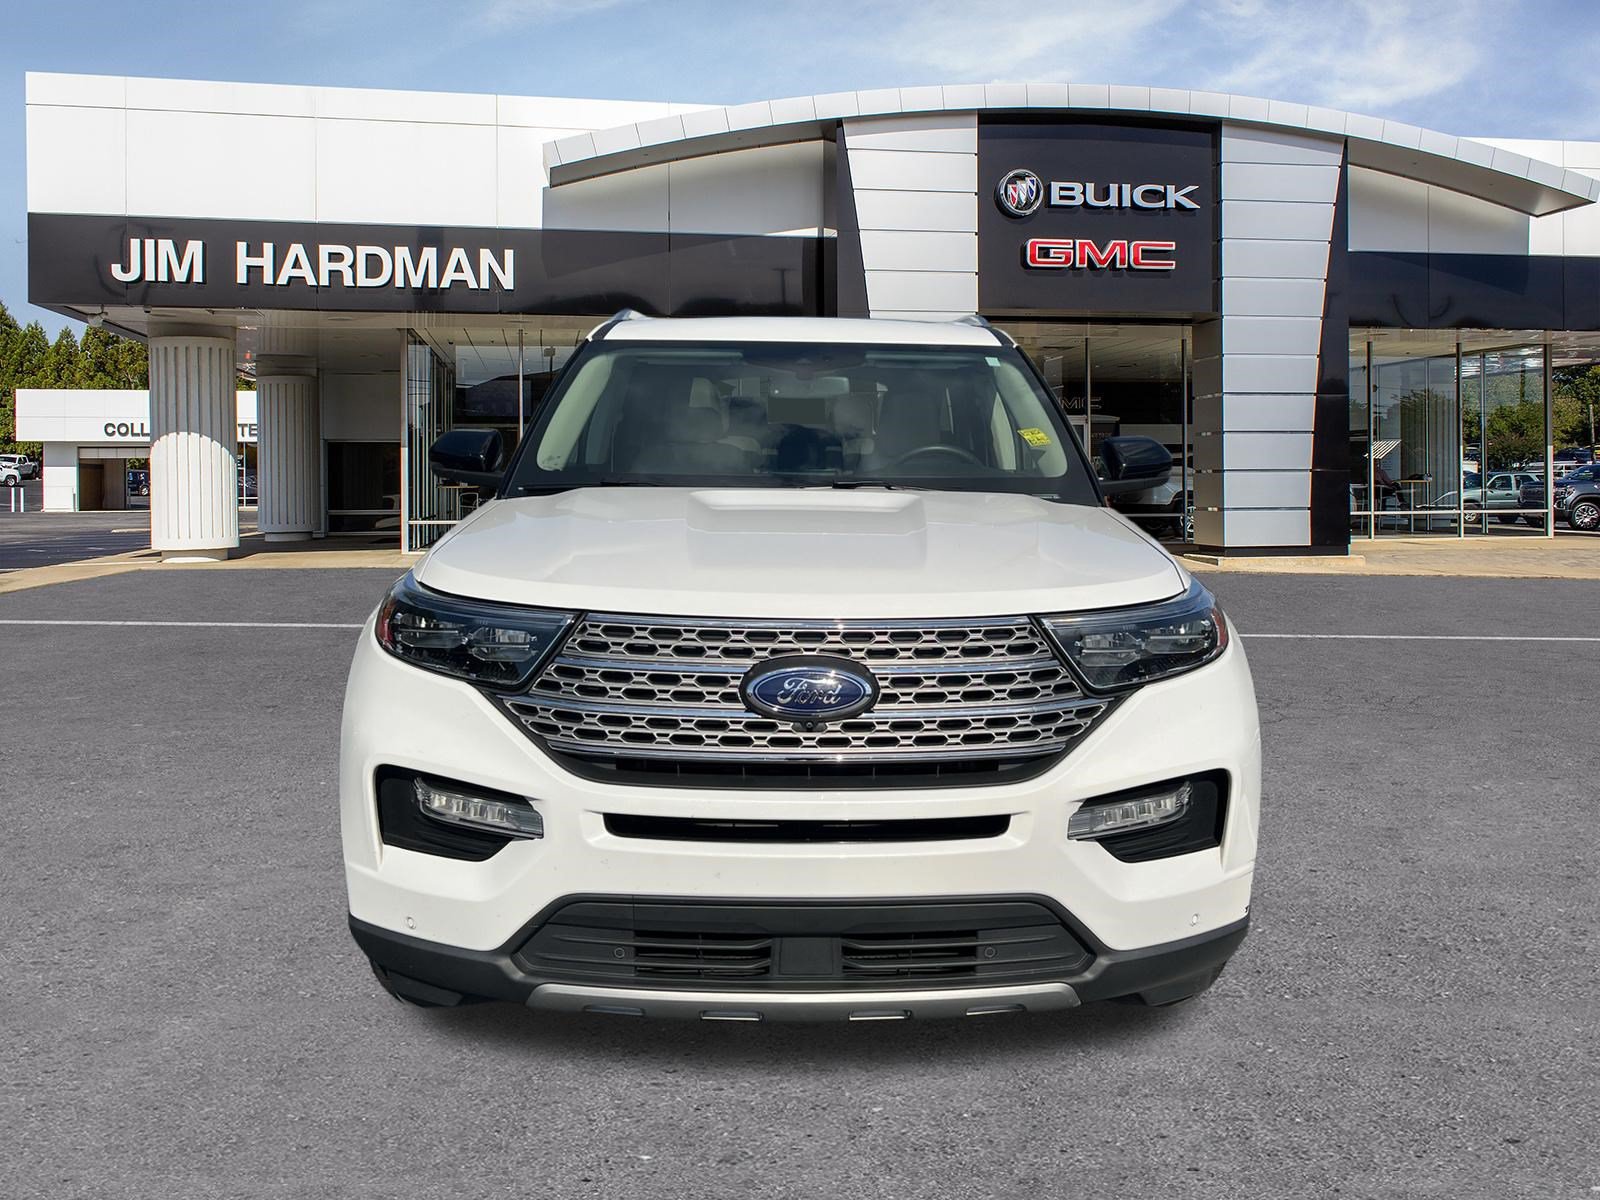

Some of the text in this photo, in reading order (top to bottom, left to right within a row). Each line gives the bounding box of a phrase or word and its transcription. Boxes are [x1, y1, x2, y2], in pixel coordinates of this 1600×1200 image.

[1050, 181, 1200, 209] BUICK
[110, 238, 515, 290] JIM HARDMAN
[1026, 238, 1176, 270] GMC
[776, 677, 842, 705] Ford
